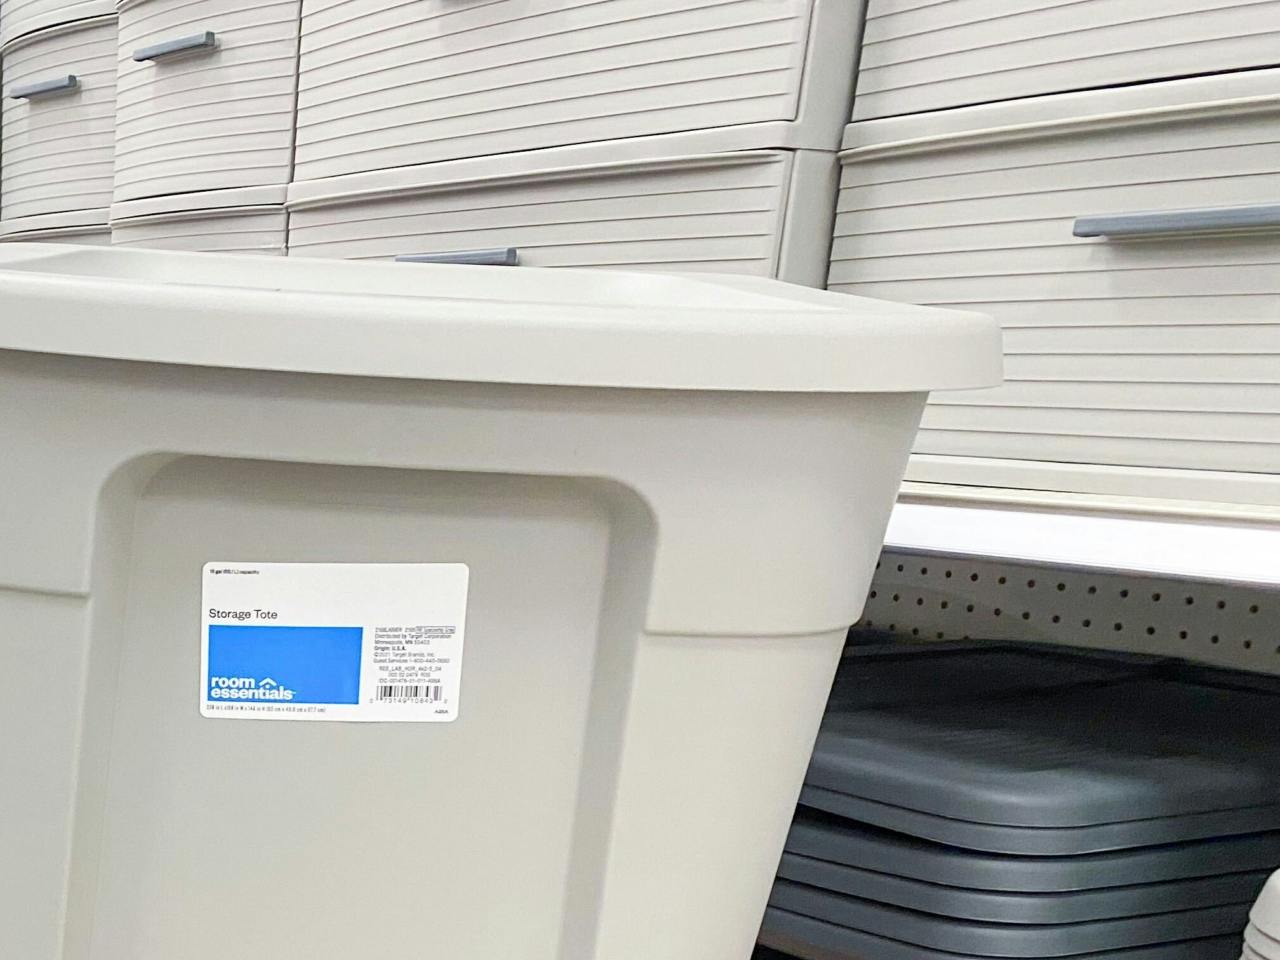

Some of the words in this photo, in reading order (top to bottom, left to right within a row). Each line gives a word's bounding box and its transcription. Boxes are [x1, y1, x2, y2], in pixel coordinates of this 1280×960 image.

[209, 608, 251, 621] Storage
[253, 609, 278, 620] Tote
[211, 676, 255, 688] room
[211, 685, 294, 700] essentials
